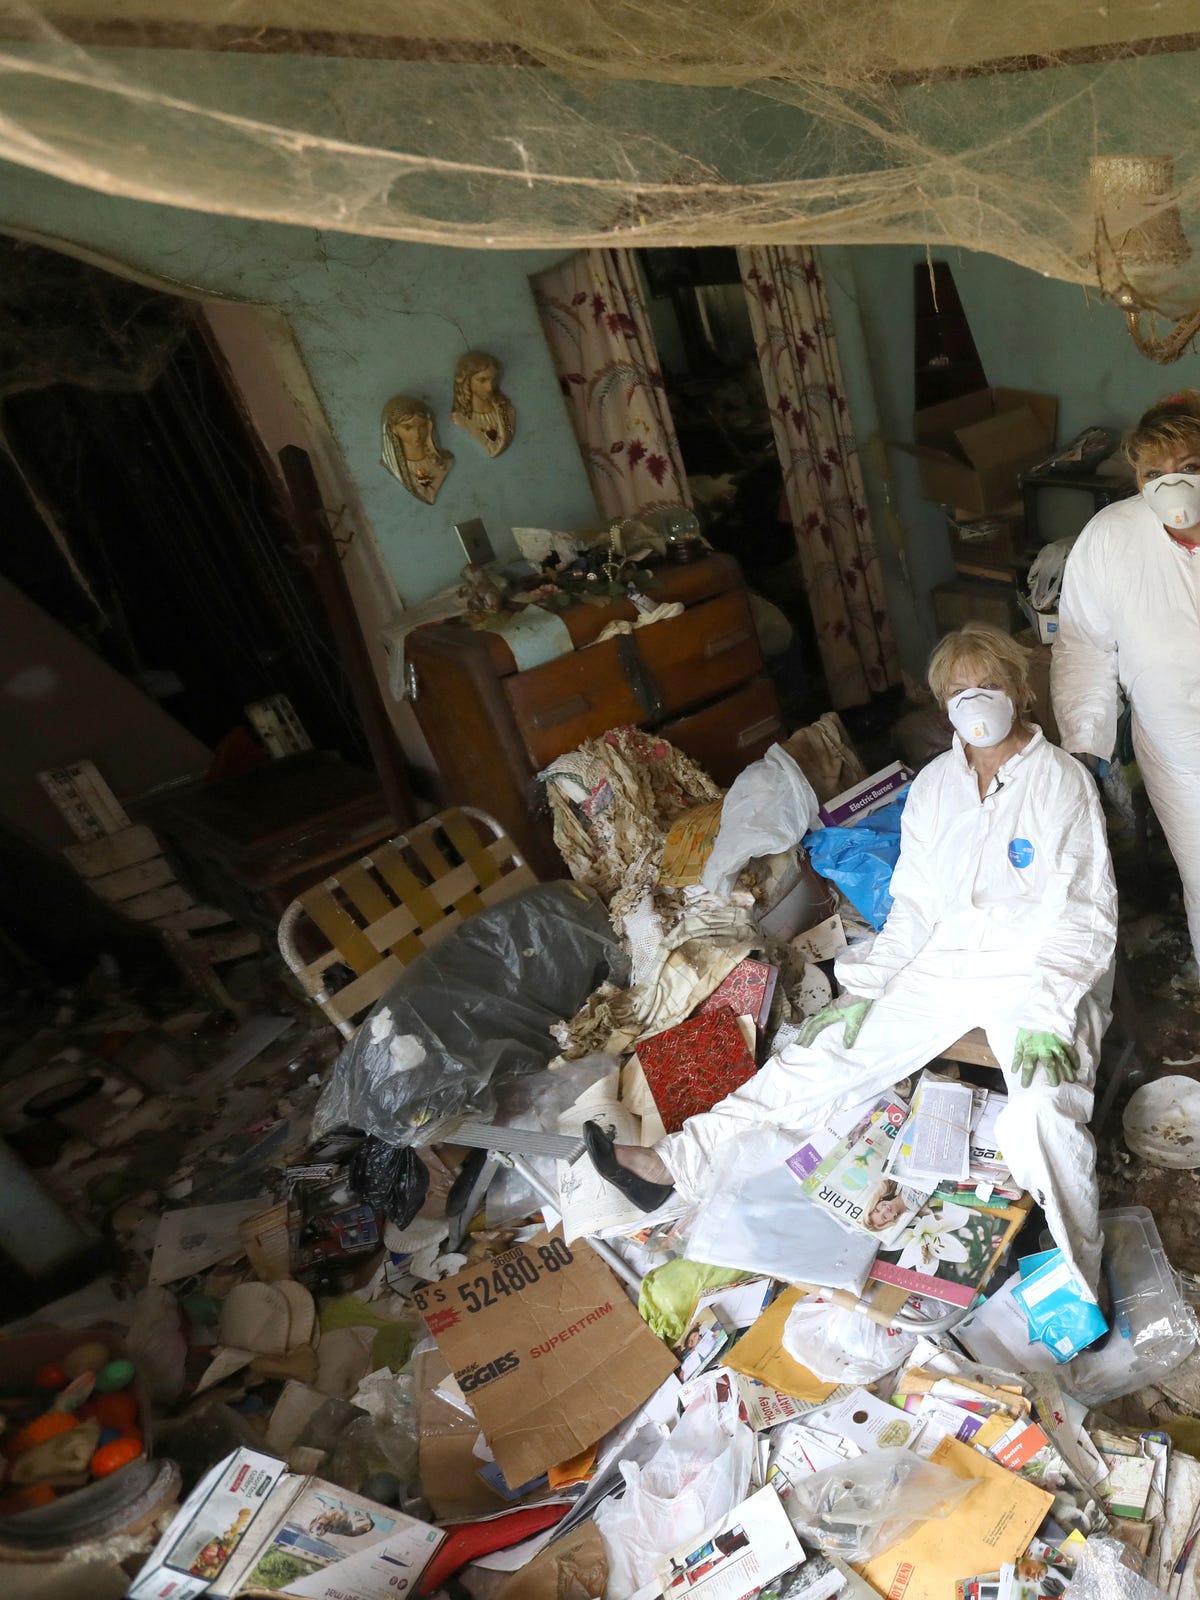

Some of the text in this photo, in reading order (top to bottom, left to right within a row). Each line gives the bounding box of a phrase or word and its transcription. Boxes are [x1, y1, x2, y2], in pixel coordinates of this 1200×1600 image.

[849, 781, 894, 813] Electric Burner
[818, 1185, 863, 1219] BLAIR
[490, 1246, 523, 1269] 36000
[457, 1235, 575, 1314] 52480-80
[529, 1301, 613, 1359] SUPERTRIM
[459, 1349, 521, 1392] GGIES
[1003, 1442, 1023, 1461] Society
[898, 1562, 914, 1585] BEND
